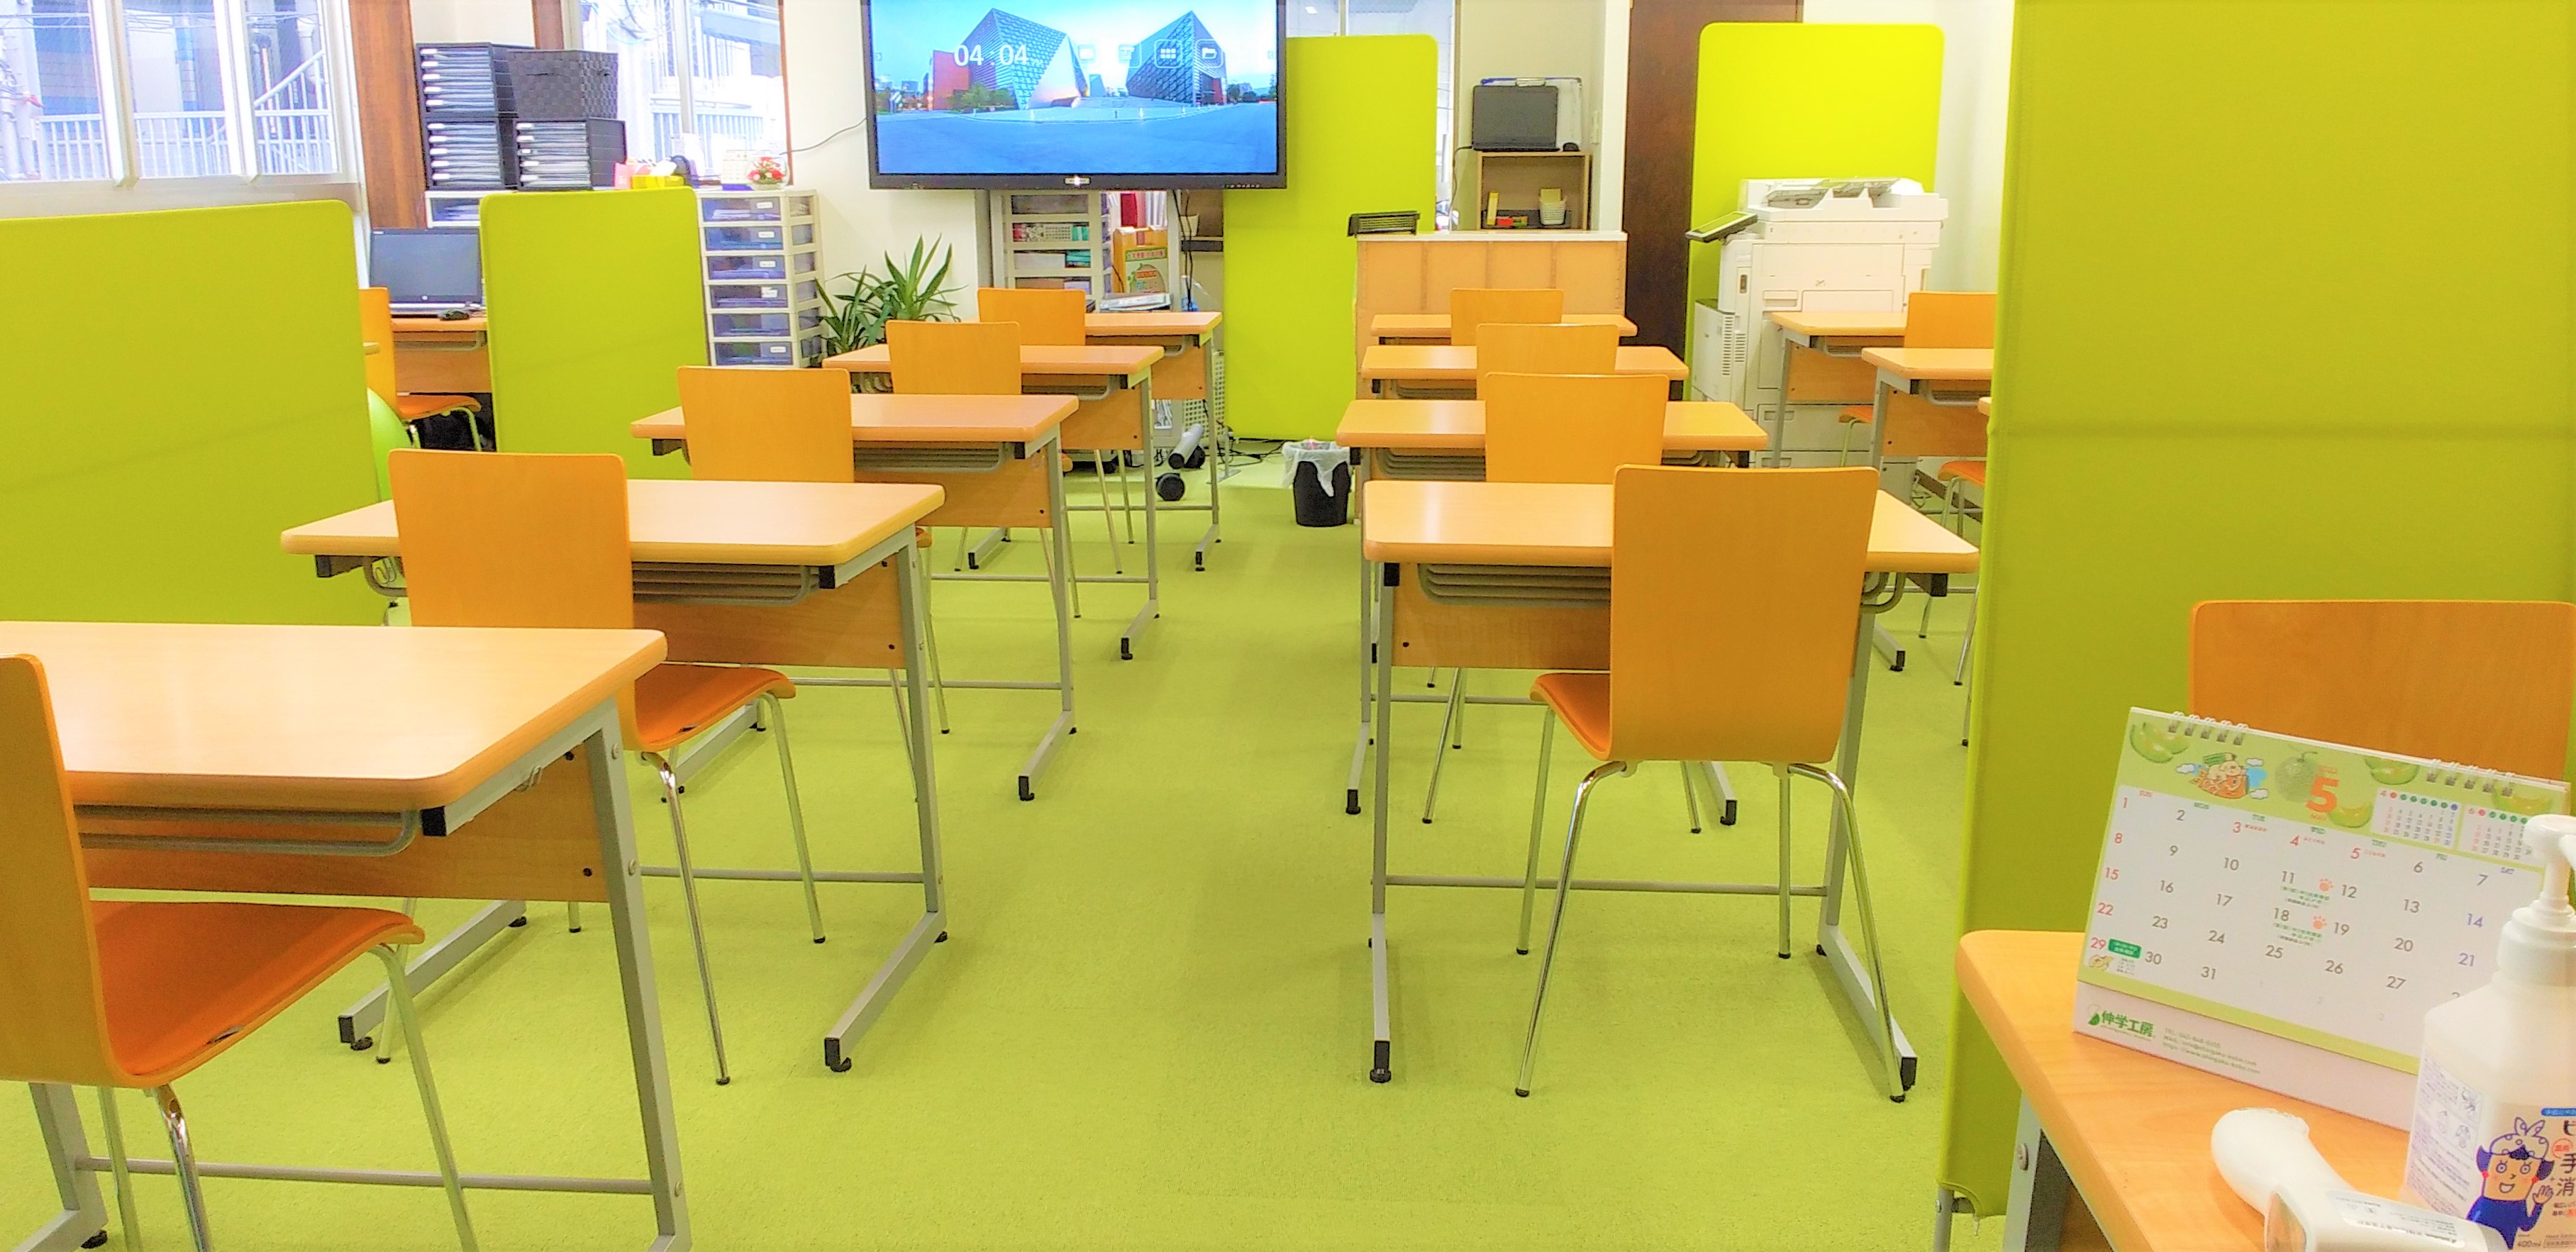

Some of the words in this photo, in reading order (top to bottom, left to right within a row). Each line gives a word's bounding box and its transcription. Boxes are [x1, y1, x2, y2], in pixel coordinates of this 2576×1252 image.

[2306, 775, 2340, 812] 5
[2123, 797, 2128, 809] 1
[2176, 809, 2185, 821] 2
[2232, 821, 2242, 833] 3
[2289, 835, 2299, 846] 4
[2350, 847, 2361, 860] 5
[2414, 861, 2424, 873] 6
[2477, 874, 2489, 886] 7
[2114, 832, 2123, 844] 8
[2170, 845, 2179, 856] 9
[2224, 857, 2239, 871] 10
[2282, 870, 2294, 884] 11
[2342, 884, 2358, 899] 12
[2404, 899, 2420, 914] 13
[2467, 913, 2483, 928] 14
[2097, 902, 2114, 916] 22
[2151, 915, 2168, 929] 23
[2208, 929, 2225, 944] 24
[2265, 945, 2284, 959] 25
[2324, 960, 2343, 975] 26
[2386, 975, 2406, 990] 27
[2106, 867, 2119, 880] 15
[2160, 880, 2174, 894] 16
[2217, 893, 2233, 907] 17
[2274, 907, 2289, 922] 18
[2334, 921, 2350, 936] 19
[2394, 937, 2414, 952] 20
[2458, 953, 2475, 967] 21
[2090, 936, 2106, 950] 29
[2145, 951, 2163, 965] 30
[2201, 966, 2216, 980] 31
[2102, 1010, 2155, 1037] 伸学工房
[2555, 1177, 2575, 1197] 消
